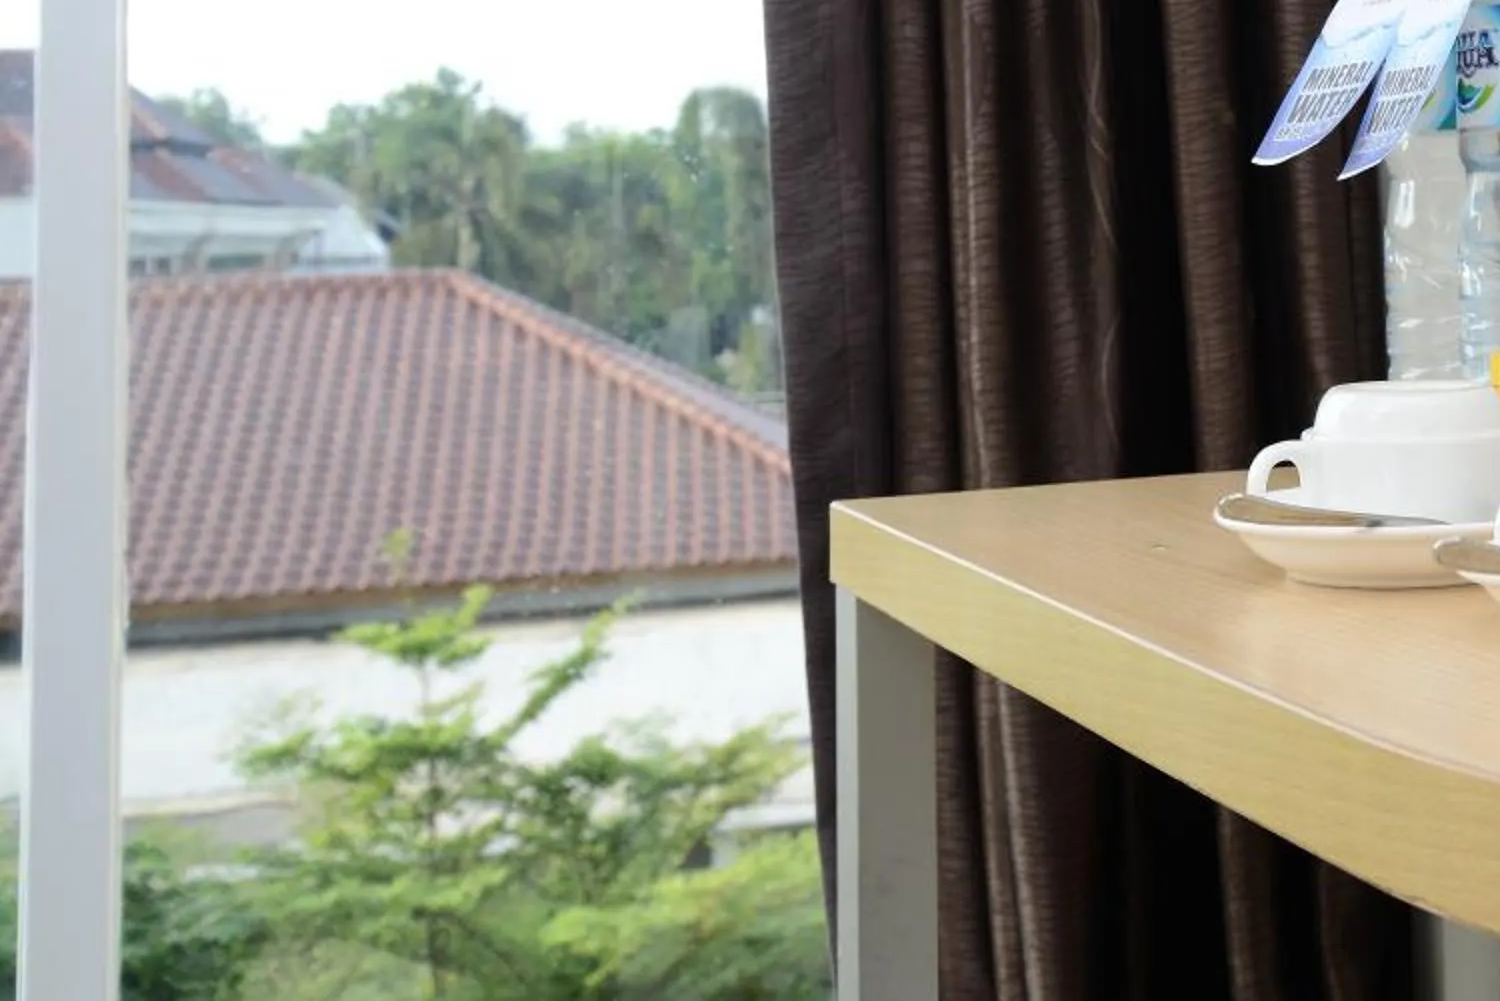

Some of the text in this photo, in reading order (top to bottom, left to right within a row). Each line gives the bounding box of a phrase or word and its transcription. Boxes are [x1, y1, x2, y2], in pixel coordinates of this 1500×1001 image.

[1304, 60, 1374, 92] MINERAL
[1381, 64, 1436, 98] MINERAL
[1287, 87, 1359, 124] WATER
[1368, 94, 1422, 135] WATER
